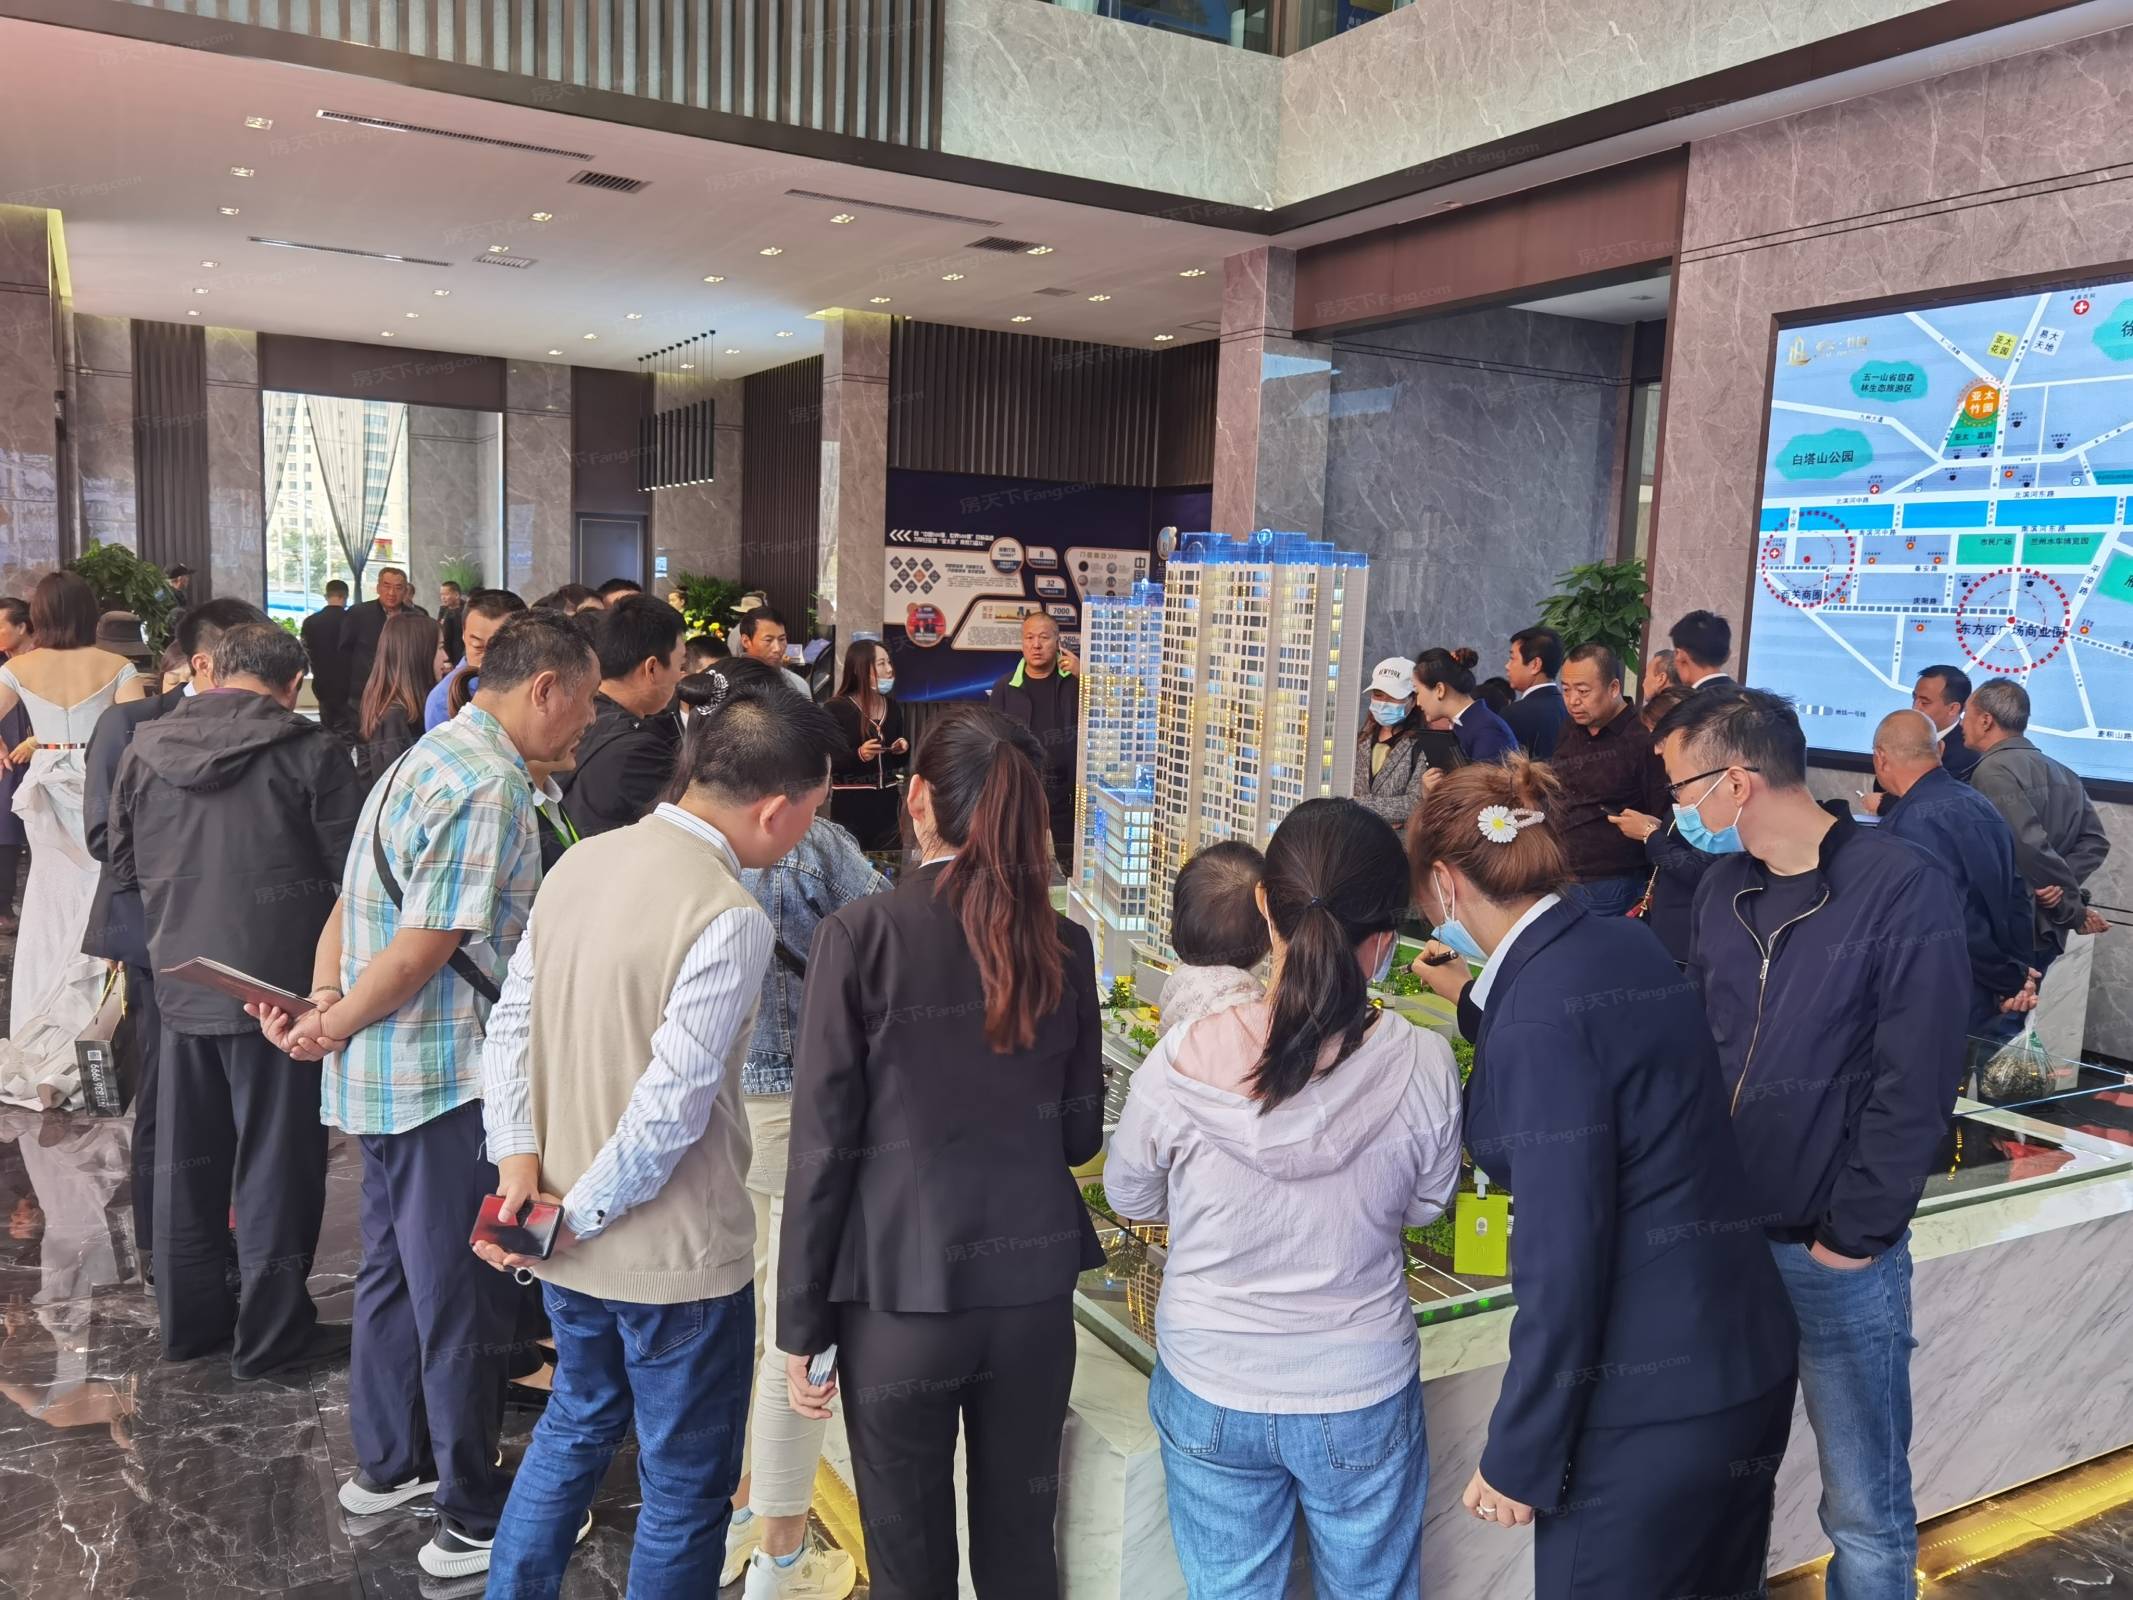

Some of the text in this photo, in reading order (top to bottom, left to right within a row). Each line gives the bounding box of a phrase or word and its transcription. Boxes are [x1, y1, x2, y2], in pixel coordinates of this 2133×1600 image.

[1971, 391, 1995, 402] 亚太
[1792, 450, 1854, 465] 白塔山公园
[1053, 607, 1070, 615] 7000
